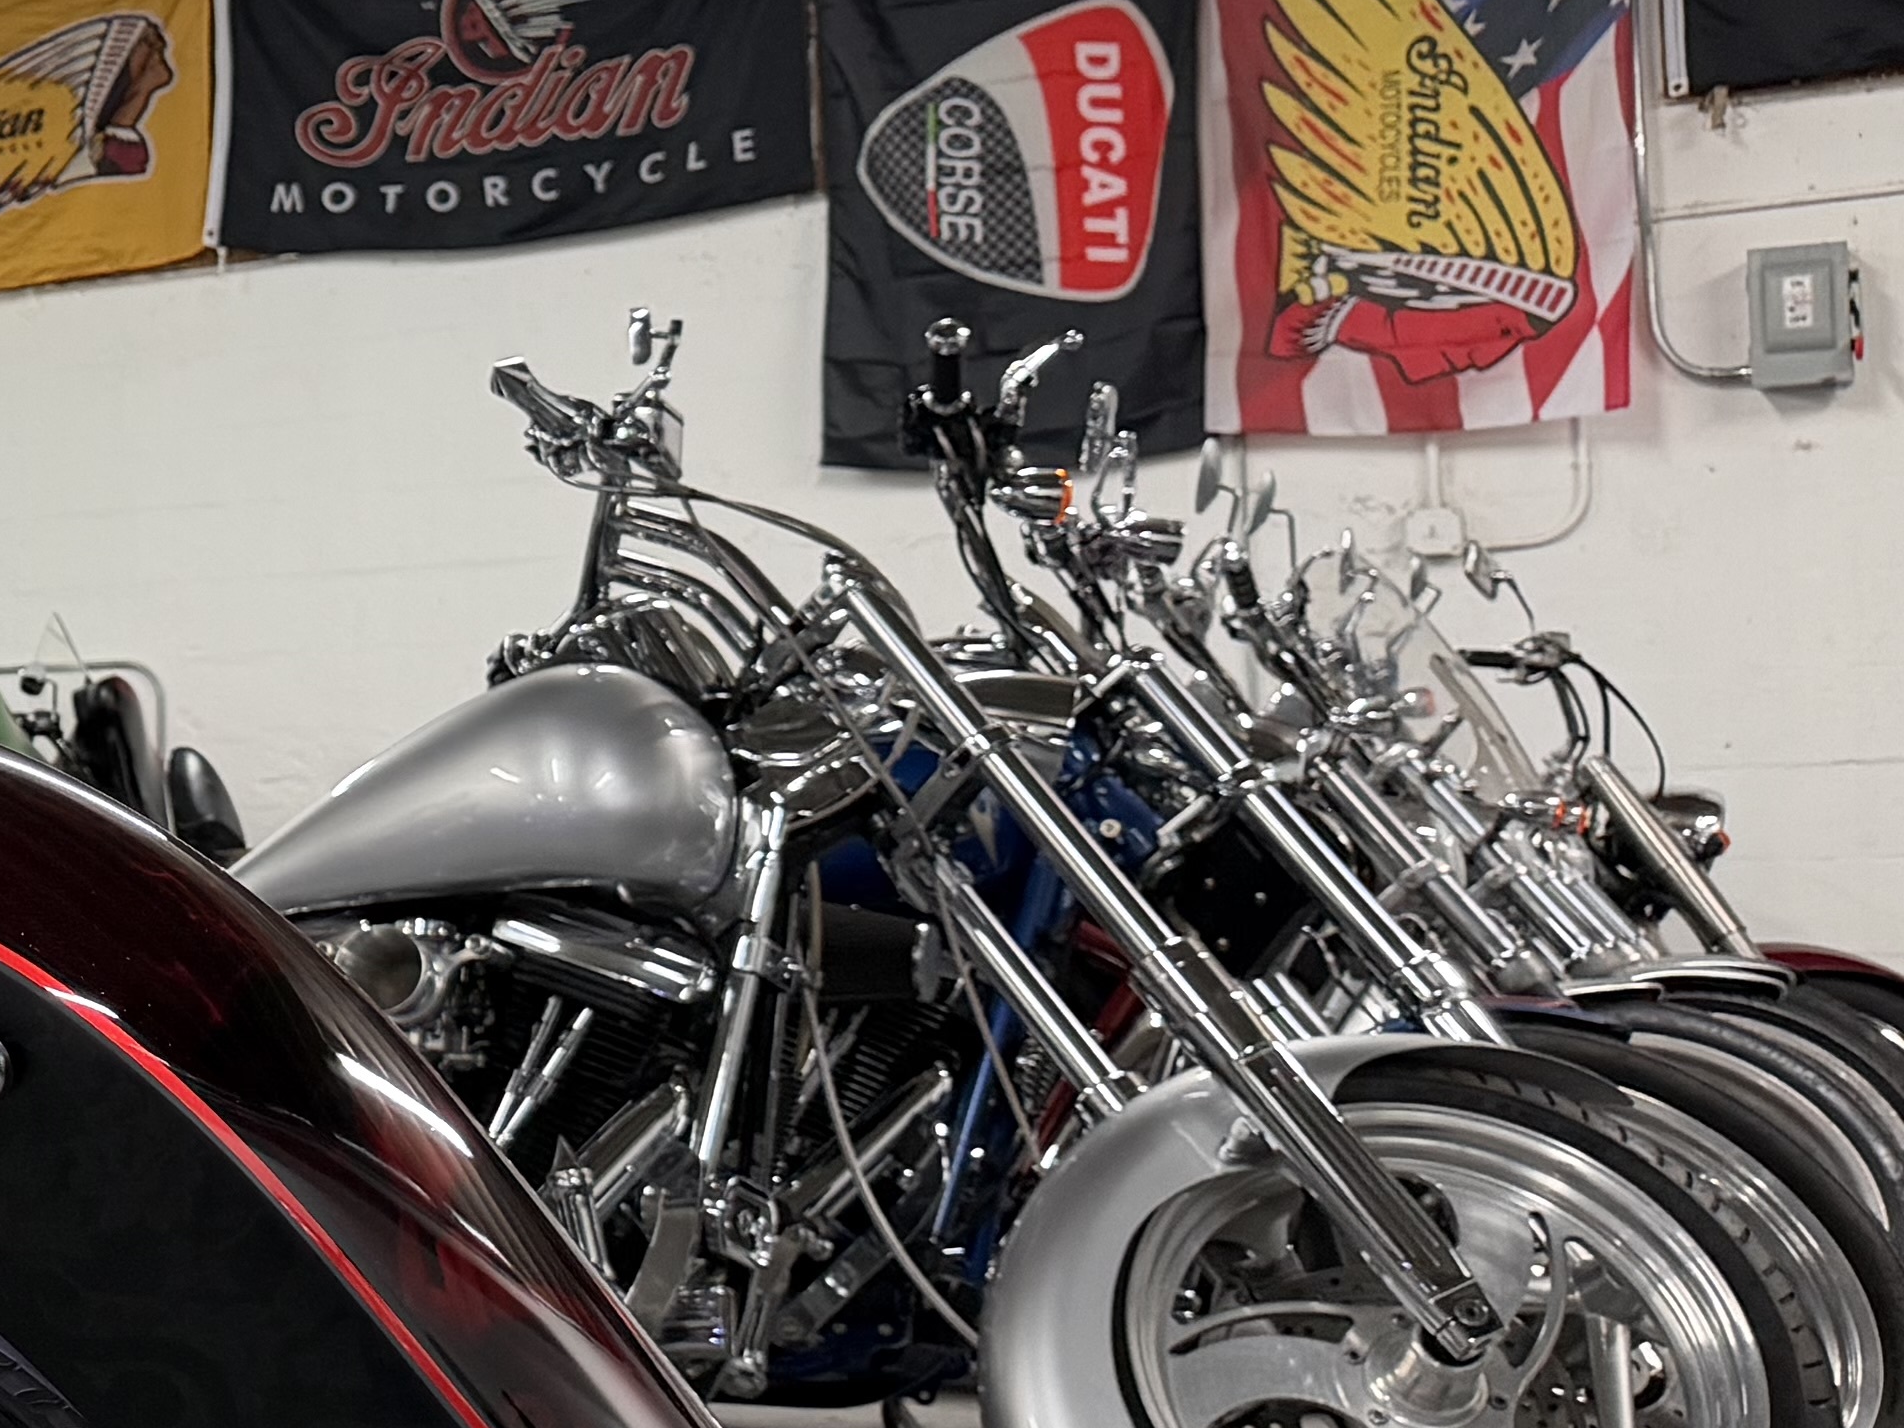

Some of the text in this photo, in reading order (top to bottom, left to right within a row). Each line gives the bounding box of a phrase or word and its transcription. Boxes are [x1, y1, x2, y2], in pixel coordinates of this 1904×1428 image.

[270, 128, 758, 213] MOTORCYCLE
[295, 36, 695, 168] Indian
[937, 97, 983, 244] CORSE
[1074, 40, 1130, 263] DUCATI
[1405, 34, 1469, 229] Indian
